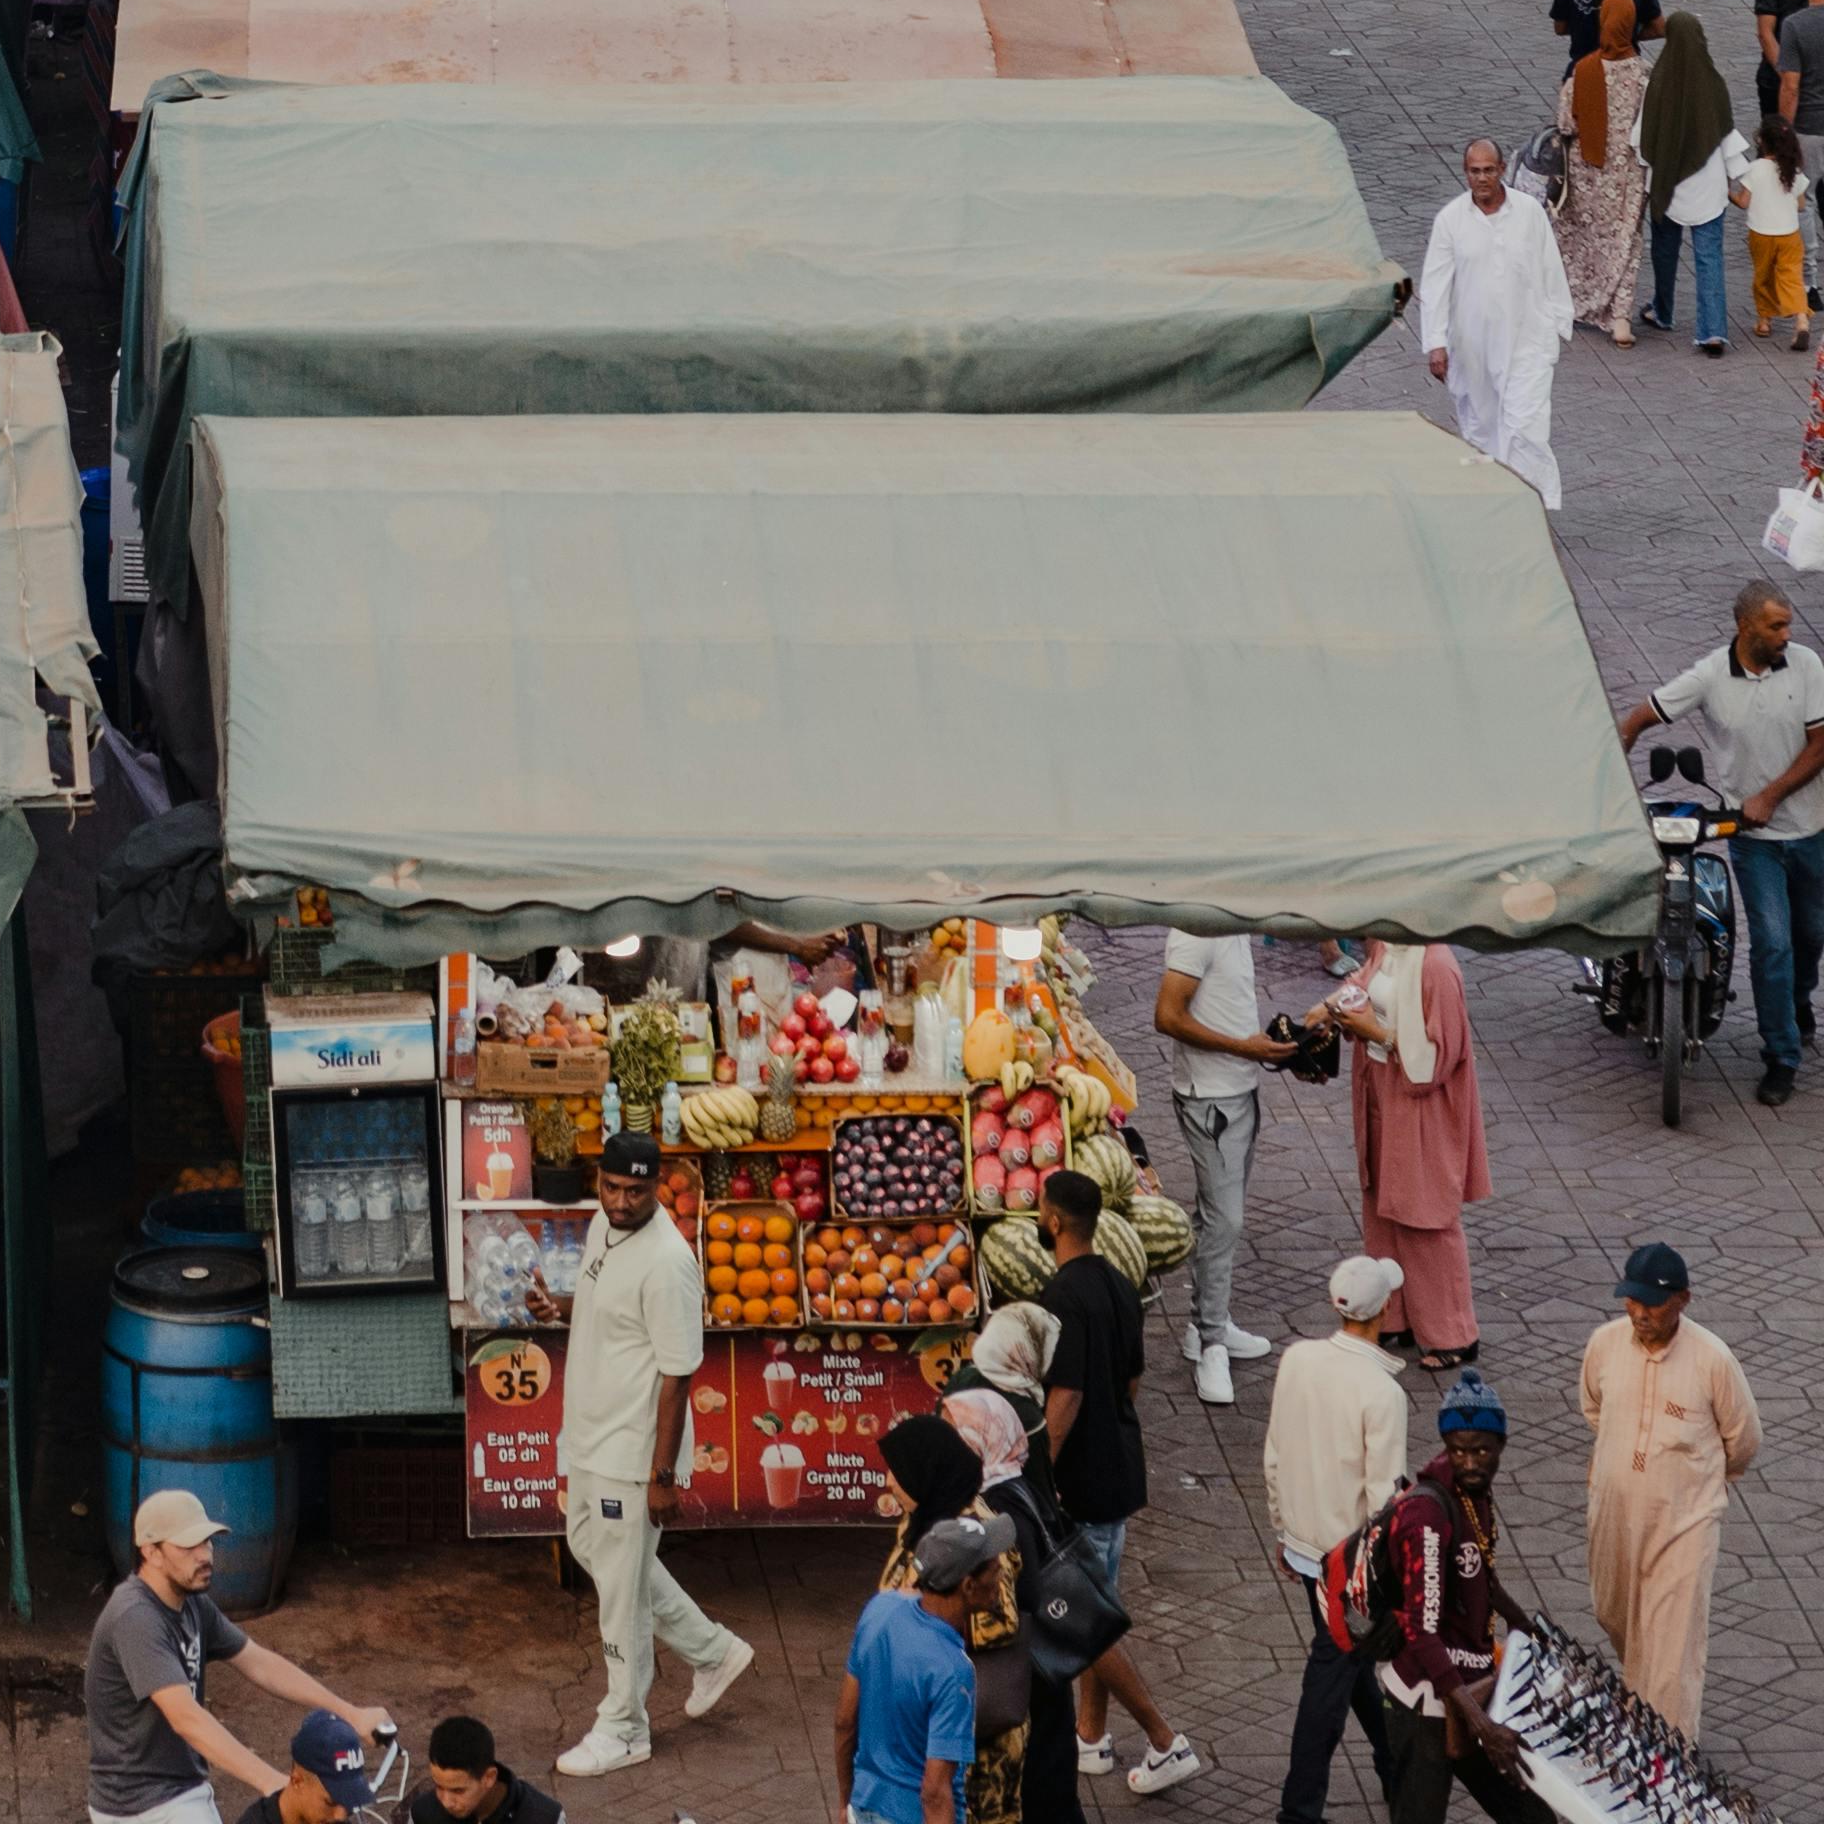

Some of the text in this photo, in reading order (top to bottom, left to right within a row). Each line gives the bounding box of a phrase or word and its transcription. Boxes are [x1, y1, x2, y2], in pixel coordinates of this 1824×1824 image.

[317, 1048, 382, 1070] Sidi ali
[483, 1127, 512, 1144] 5dh
[822, 1355, 861, 1369] Mixte
[495, 1369, 540, 1402] 35
[800, 1373, 833, 1388] Petit
[844, 1372, 884, 1387] Small
[824, 1389, 862, 1403] 10 dh
[487, 1431, 551, 1447] Eau Petit
[498, 1447, 540, 1463] 05 dh
[826, 1453, 865, 1468] Mixte
[483, 1477, 557, 1493] Eau Grand
[806, 1471, 850, 1486] Grand
[861, 1470, 887, 1488] Big
[826, 1486, 866, 1500] 20 dh
[501, 1494, 541, 1509] 10 dh
